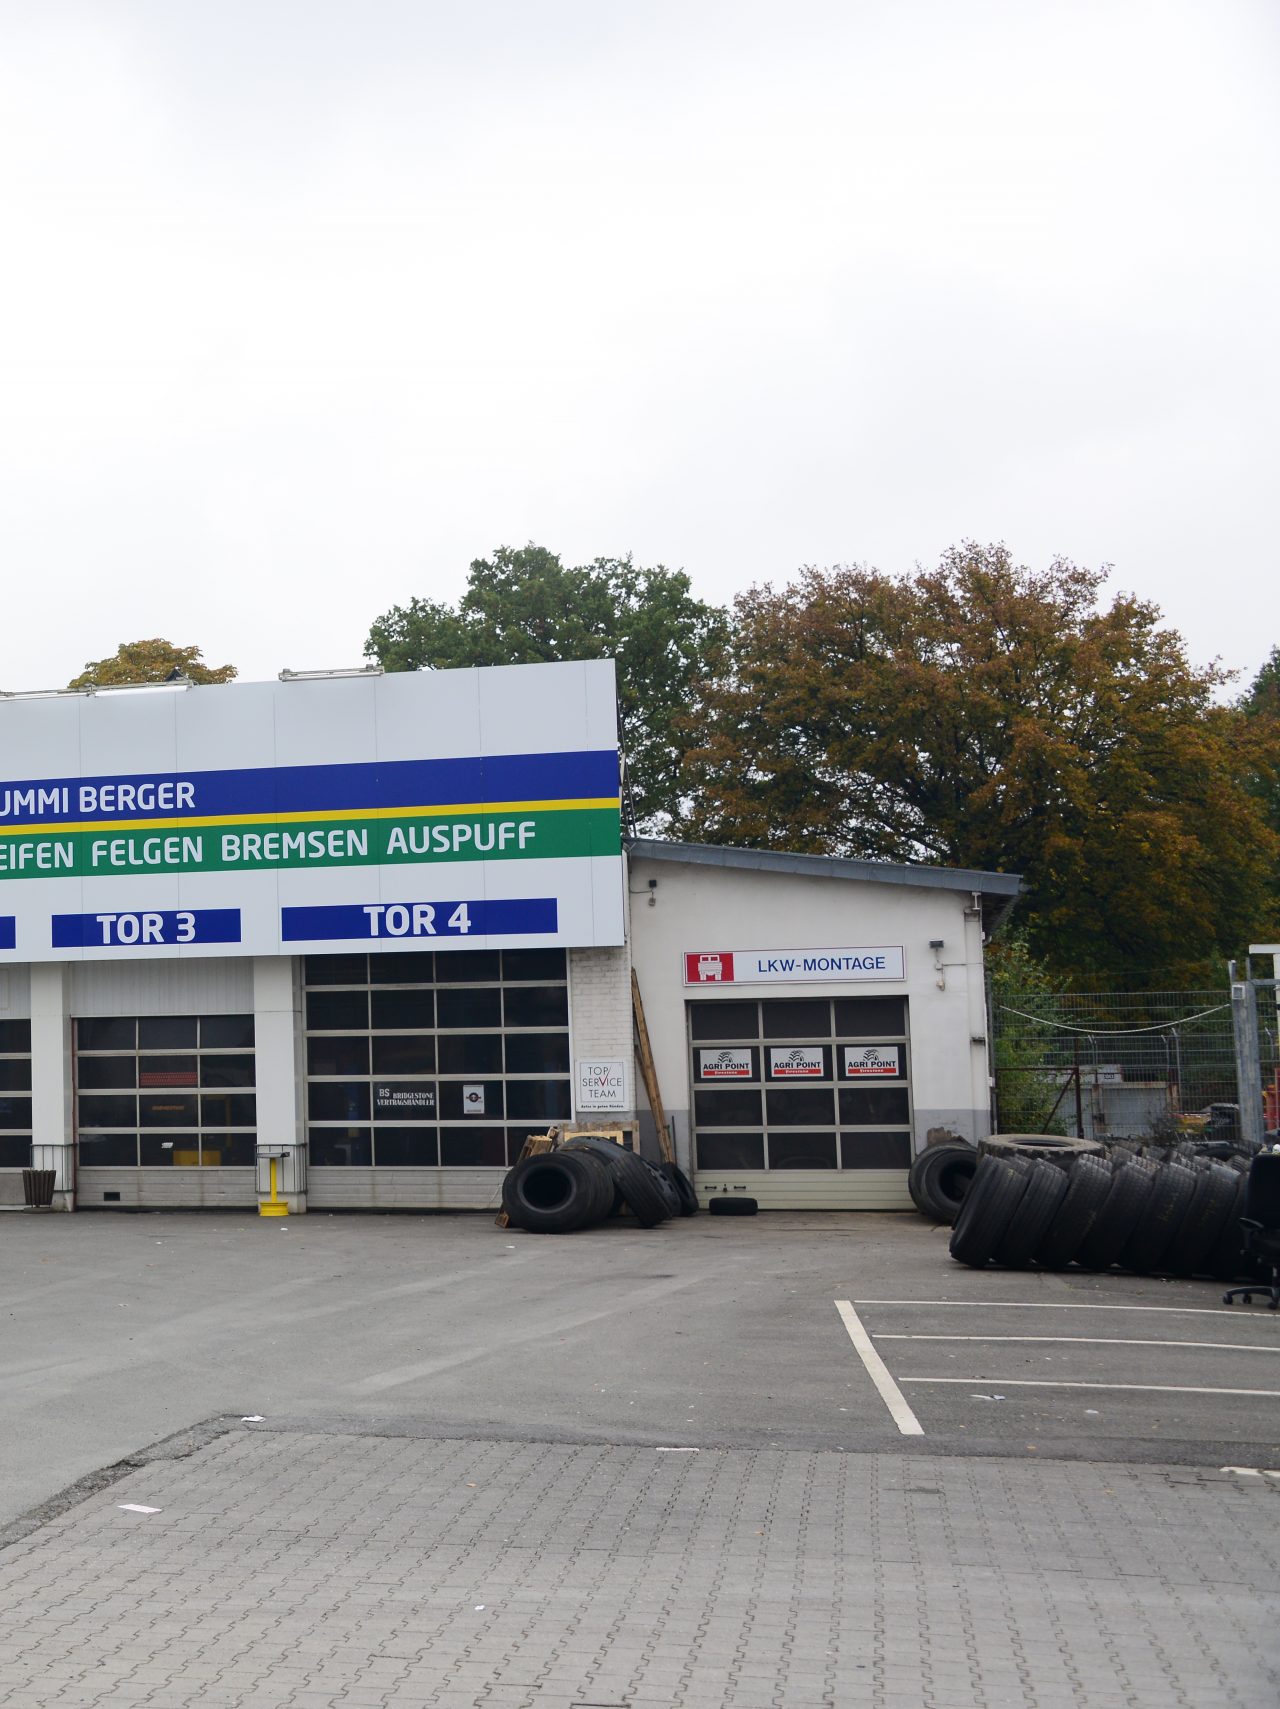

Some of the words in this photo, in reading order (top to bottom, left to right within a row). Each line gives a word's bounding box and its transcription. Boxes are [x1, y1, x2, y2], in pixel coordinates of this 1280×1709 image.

[79, 782, 196, 813] BERGER
[91, 836, 203, 867] FELGEN
[221, 828, 369, 862] BREMSEN
[386, 821, 536, 855] AUSPUFF
[96, 913, 165, 944] TOR
[176, 912, 196, 942] 3
[363, 904, 437, 936] TOR
[447, 903, 472, 934] 4
[758, 956, 886, 973] LKW-MONTAGE
[588, 1066, 609, 1076] TOP
[582, 1077, 622, 1087] SERVICE
[379, 1088, 390, 1097] BS
[589, 1089, 617, 1098] TEAM
